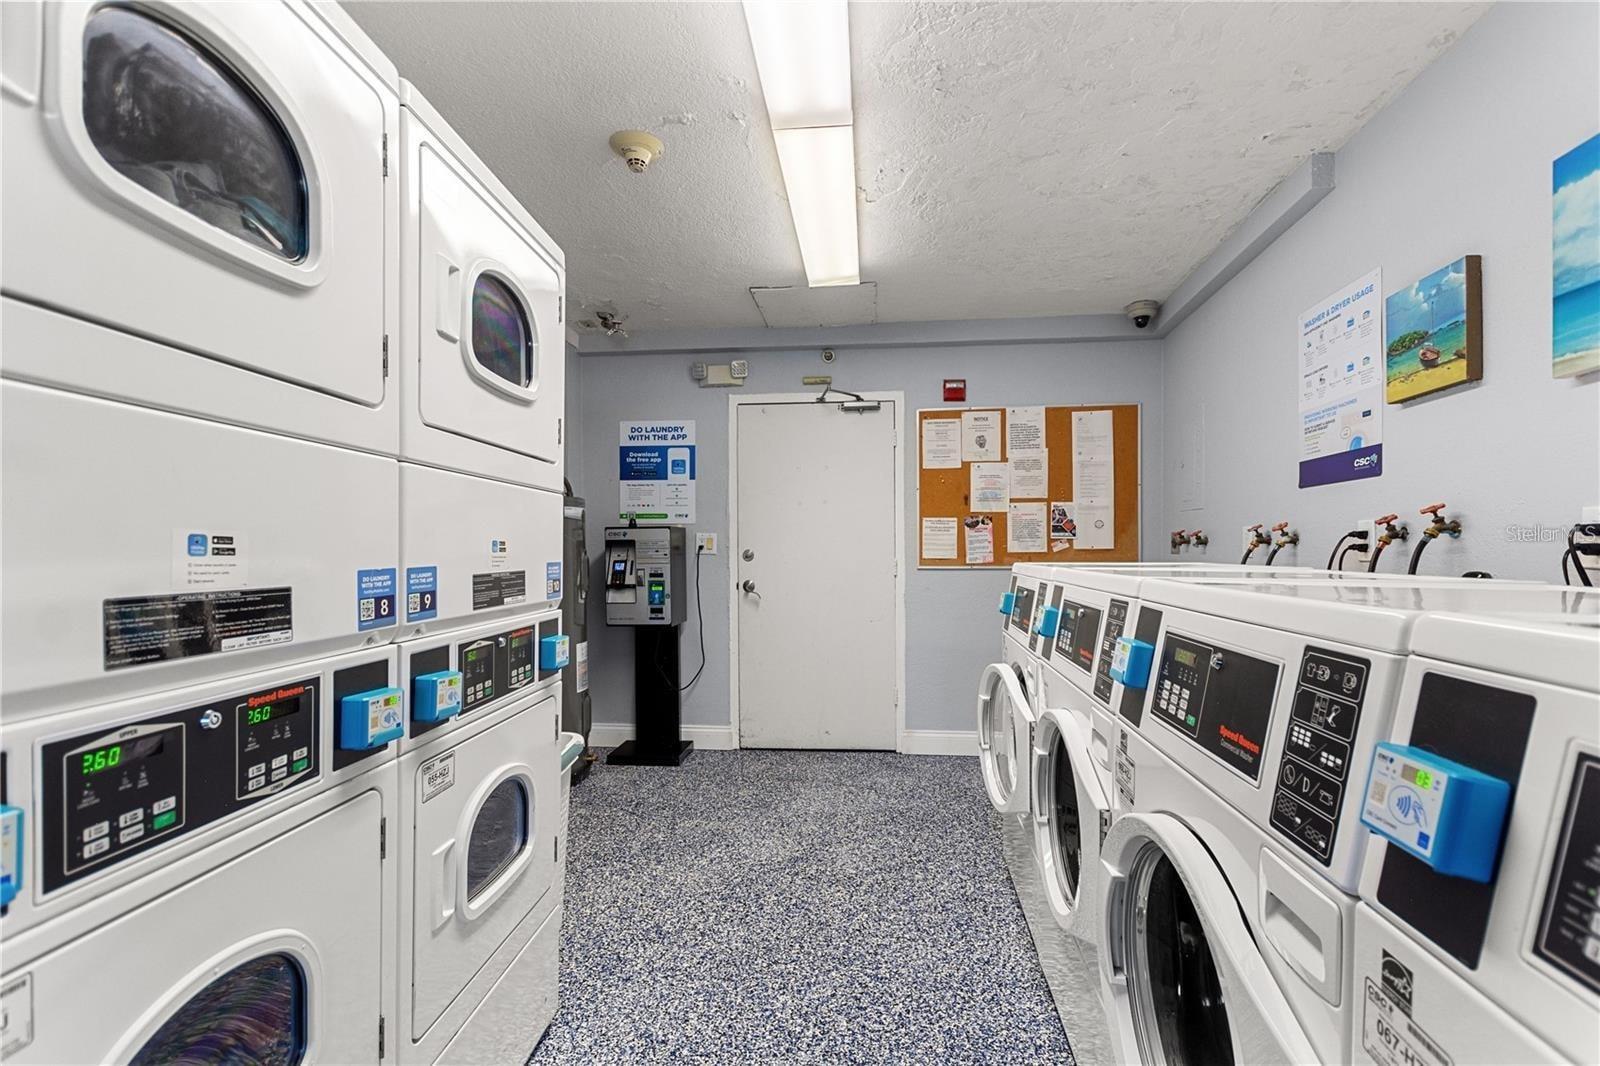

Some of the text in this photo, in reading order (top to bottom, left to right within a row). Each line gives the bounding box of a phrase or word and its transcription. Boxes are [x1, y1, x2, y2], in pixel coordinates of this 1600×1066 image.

[1304, 312, 1325, 329] WASHER
[1331, 297, 1351, 314] DRYER
[1351, 283, 1375, 302] USAGE
[670, 433, 687, 441] APP
[1354, 457, 1370, 467] CSC
[381, 599, 388, 616] 8
[424, 594, 431, 609] 9
[247, 685, 305, 708] Speed Queen
[119, 729, 138, 739] UPPER
[1219, 724, 1260, 754] Speed Queen
[270, 782, 284, 791] LOWER
[1368, 985, 1387, 1008] CSC
